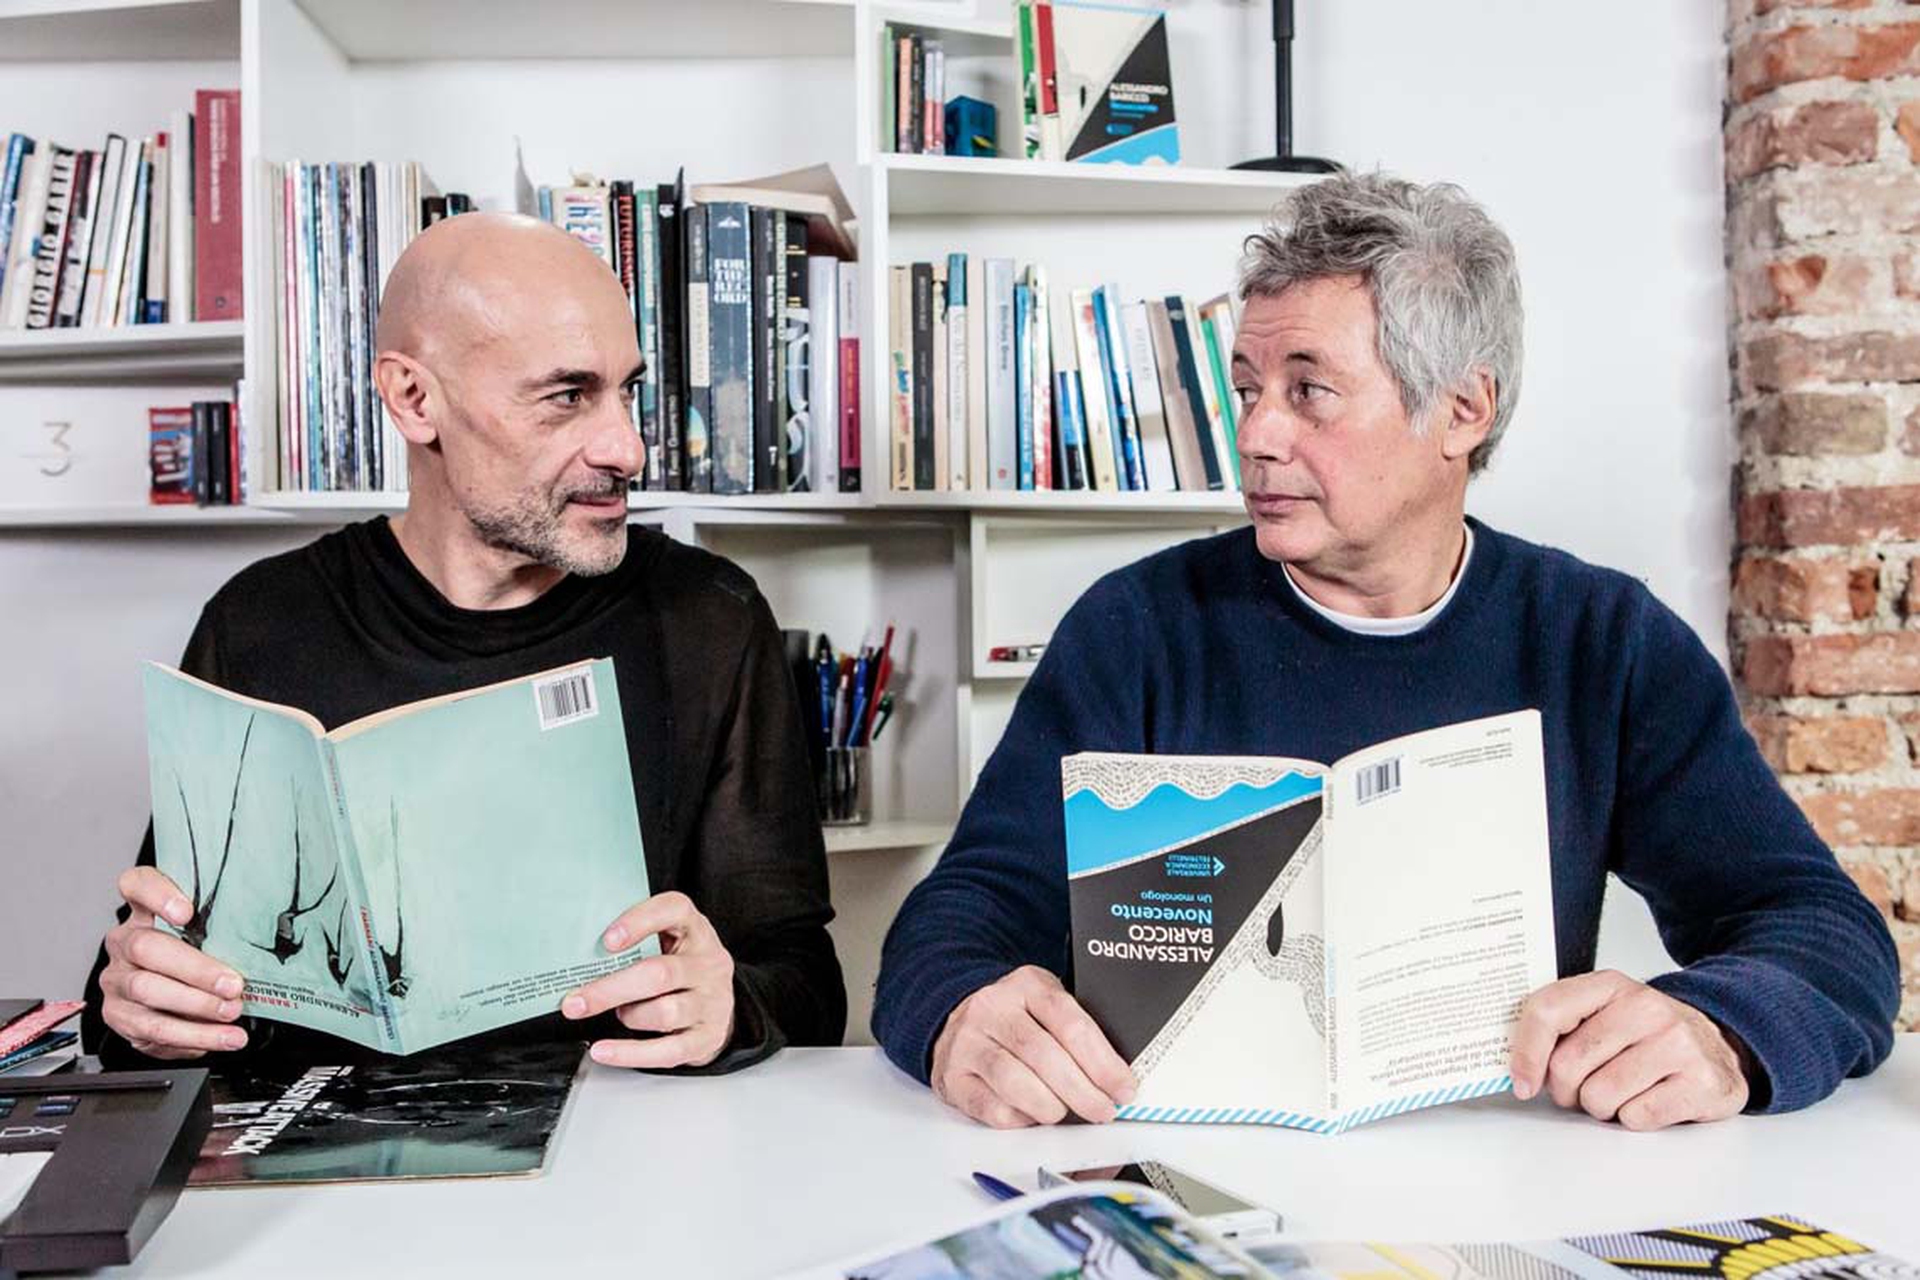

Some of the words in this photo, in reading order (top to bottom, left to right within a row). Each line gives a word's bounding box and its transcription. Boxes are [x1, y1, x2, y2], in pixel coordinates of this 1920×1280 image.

[1167, 854, 1211, 863] FELTRINELLI
[1164, 861, 1211, 870] ECONOMICA
[1166, 869, 1211, 877] UNIVERSALE
[1140, 890, 1195, 903] monologo
[1197, 893, 1213, 904] Un
[1110, 904, 1213, 925] Novecento
[1128, 924, 1214, 944] BARICCO
[1087, 938, 1214, 964] ALESSANDRO
[290, 992, 360, 1019] ALESSANDRO
